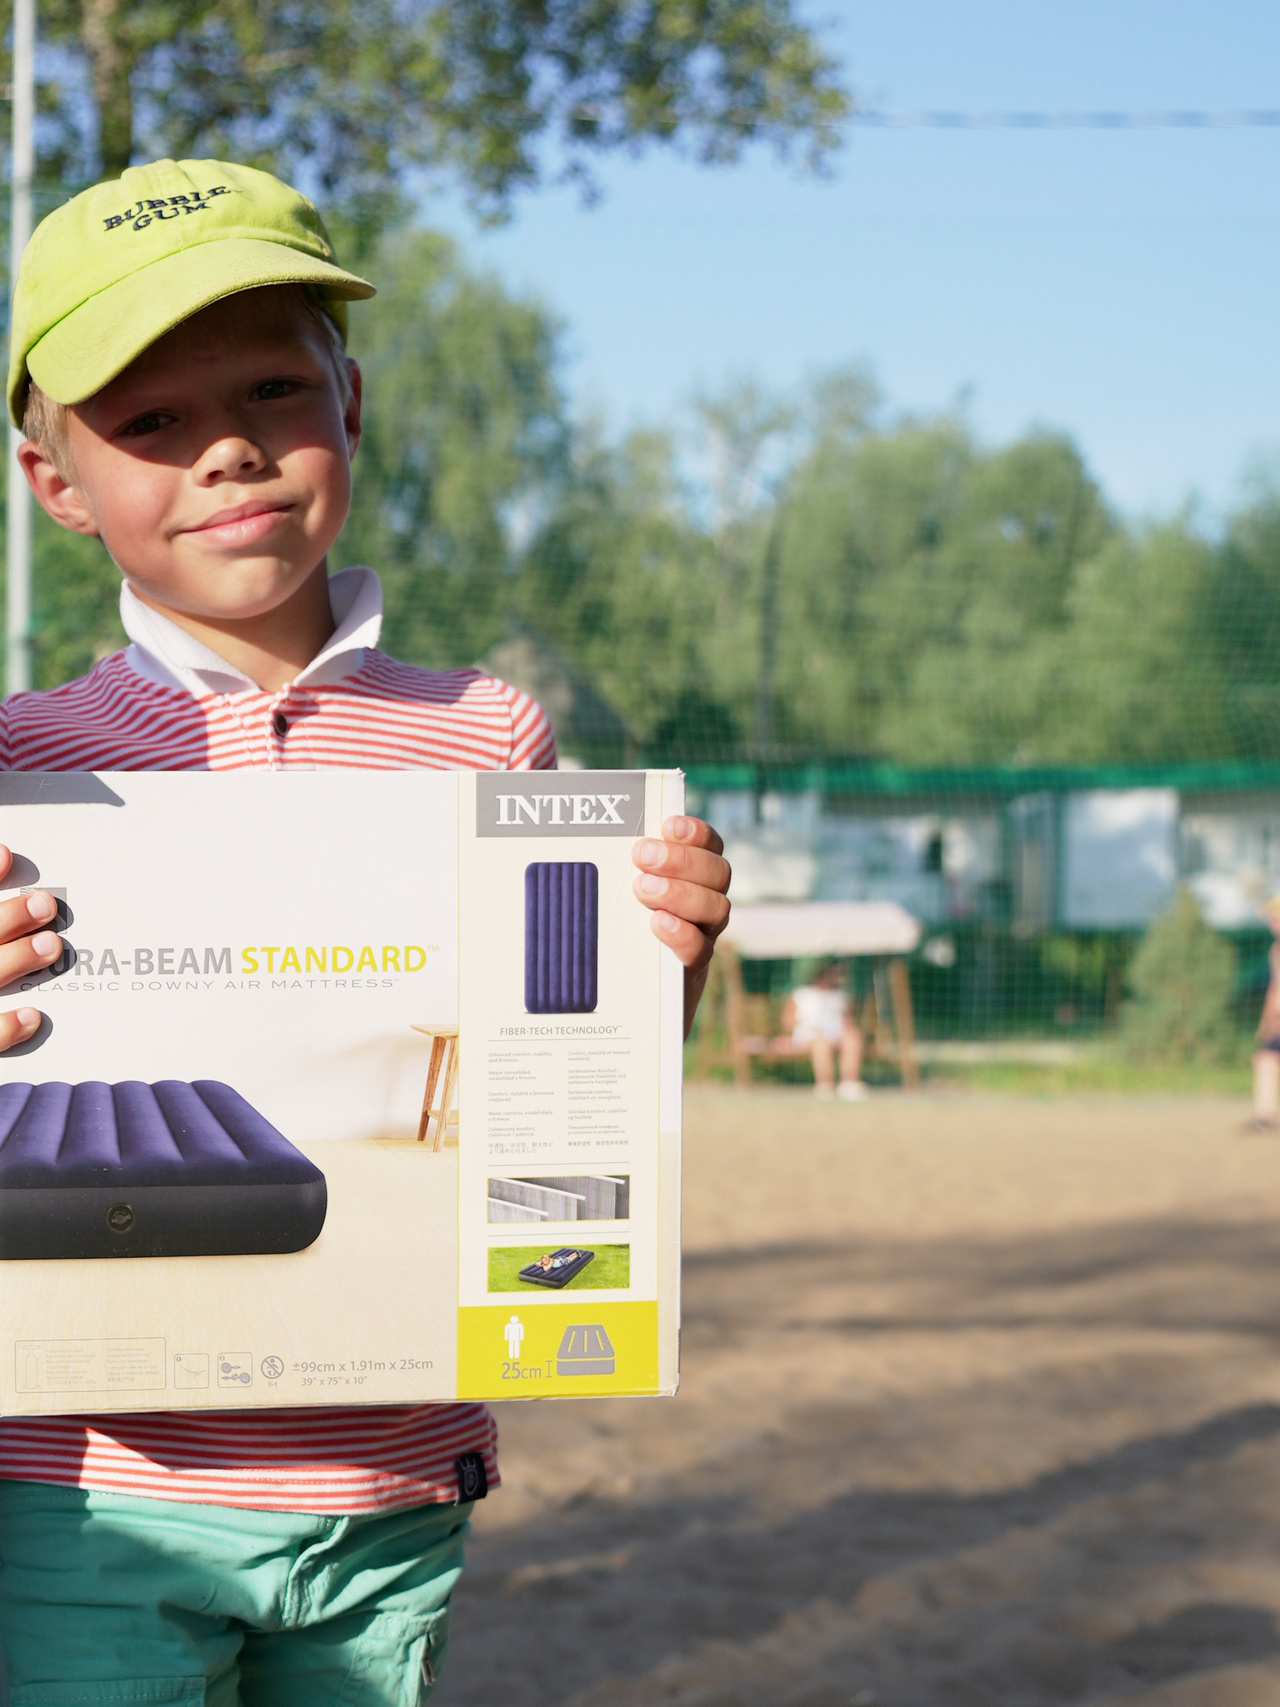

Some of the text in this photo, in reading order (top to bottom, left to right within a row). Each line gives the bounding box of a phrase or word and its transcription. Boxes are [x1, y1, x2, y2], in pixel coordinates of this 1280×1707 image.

[103, 186, 232, 231] BUBBLE
[133, 202, 211, 231] GUM
[25, 946, 232, 977] URA-BEAM
[20, 982, 120, 992] CLASSIC
[131, 981, 214, 991] DOWNY
[224, 980, 261, 990] AIR
[500, 1027, 553, 1036] FIBER-TECH
[339, 1363, 346, 1371] x
[350, 1360, 386, 1371] 1.91m
[389, 1362, 396, 1370] x
[400, 1359, 434, 1370] 25cm
[501, 1361, 542, 1379] 25cm
